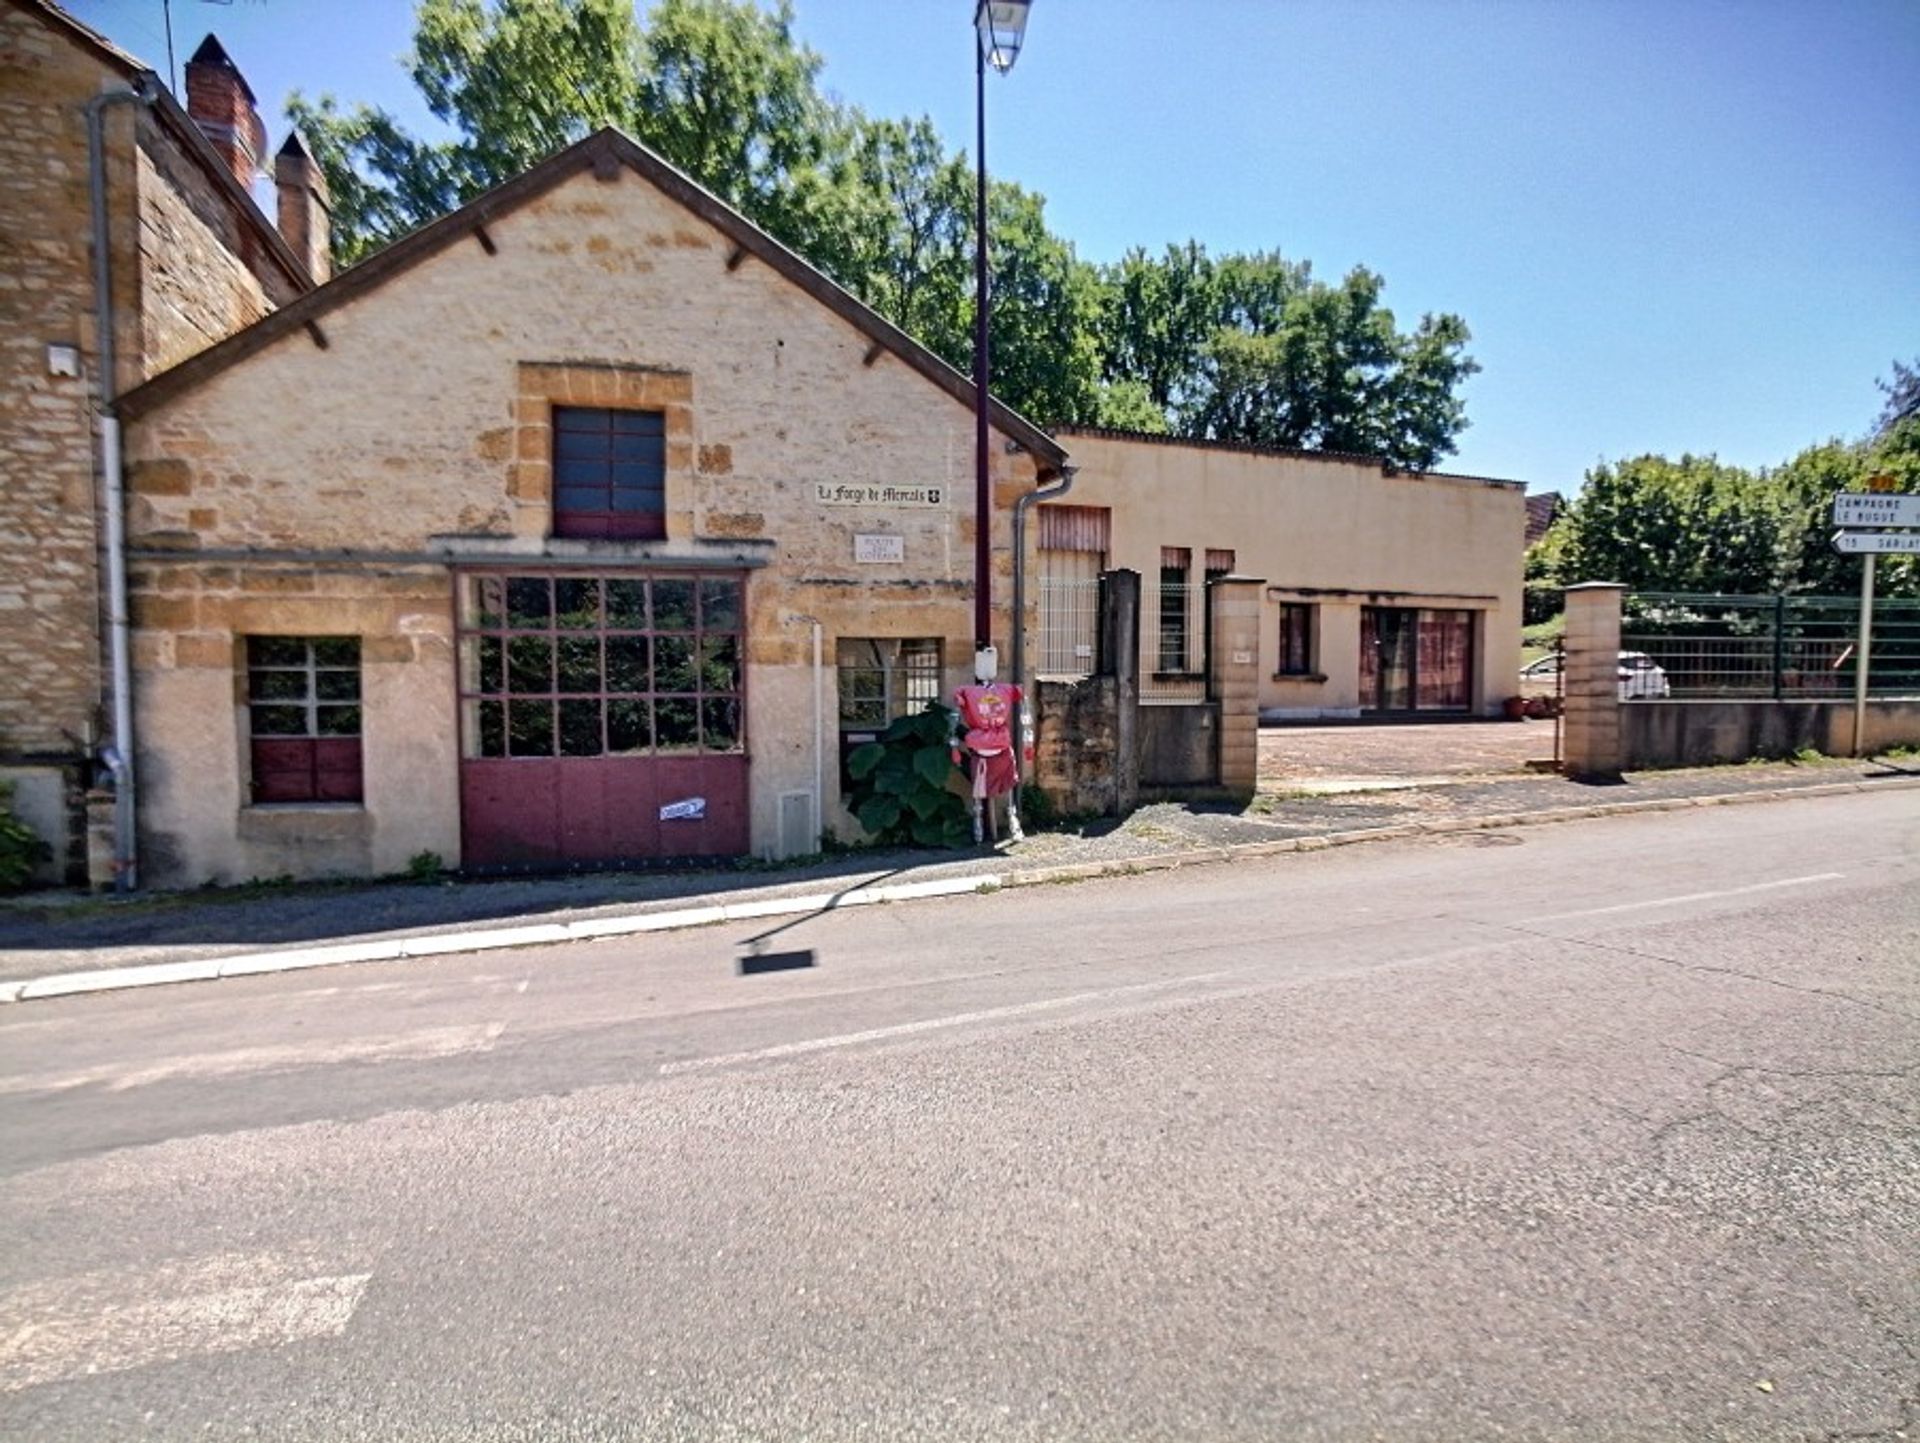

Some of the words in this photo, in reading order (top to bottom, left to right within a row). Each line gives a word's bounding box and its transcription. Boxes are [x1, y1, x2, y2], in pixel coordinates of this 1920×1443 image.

[818, 485, 831, 500] La
[834, 485, 865, 503] Forge
[868, 487, 879, 501] de
[1838, 498, 1900, 510] CAMPAGNE
[1837, 511, 1850, 522] LE
[1858, 512, 1896, 522] BUGUE
